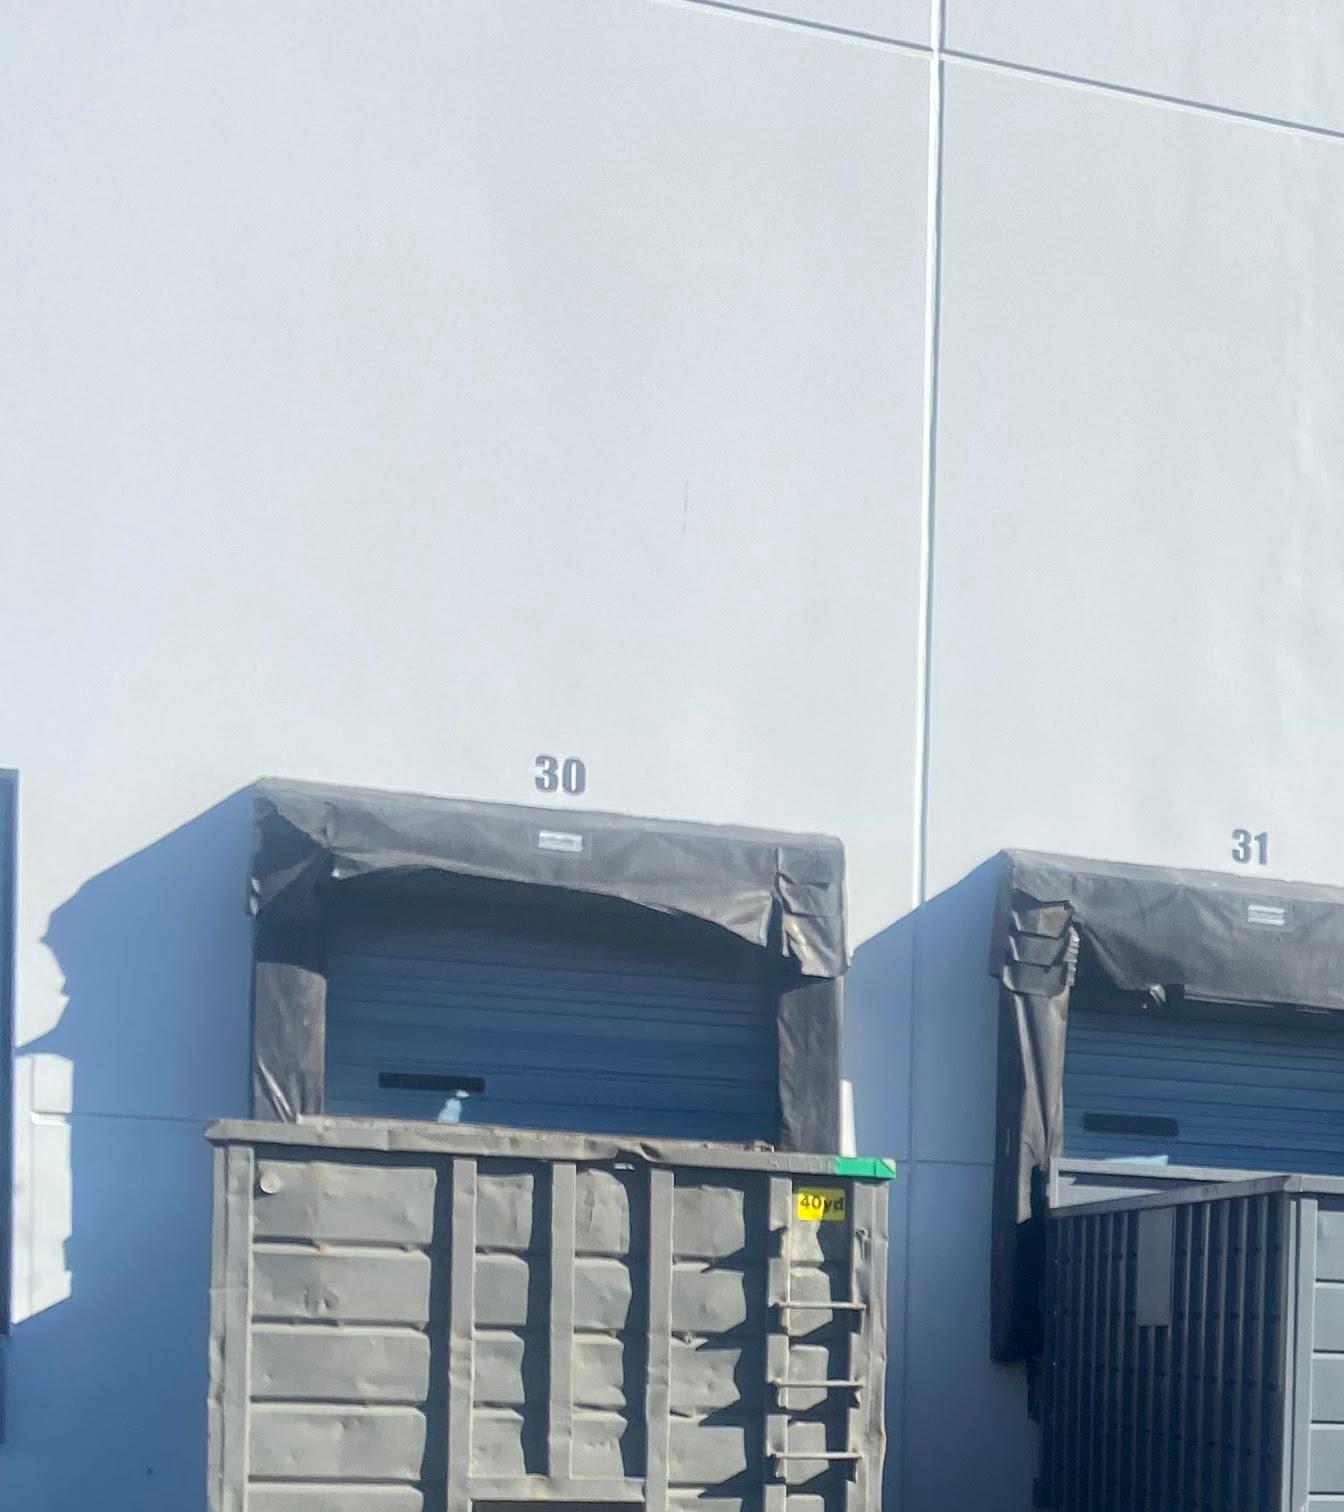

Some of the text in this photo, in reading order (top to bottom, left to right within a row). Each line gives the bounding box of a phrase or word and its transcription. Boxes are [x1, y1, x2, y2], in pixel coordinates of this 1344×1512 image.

[535, 755, 586, 796] 30
[1231, 829, 1268, 866] 31
[799, 1195, 845, 1214] 40yd
